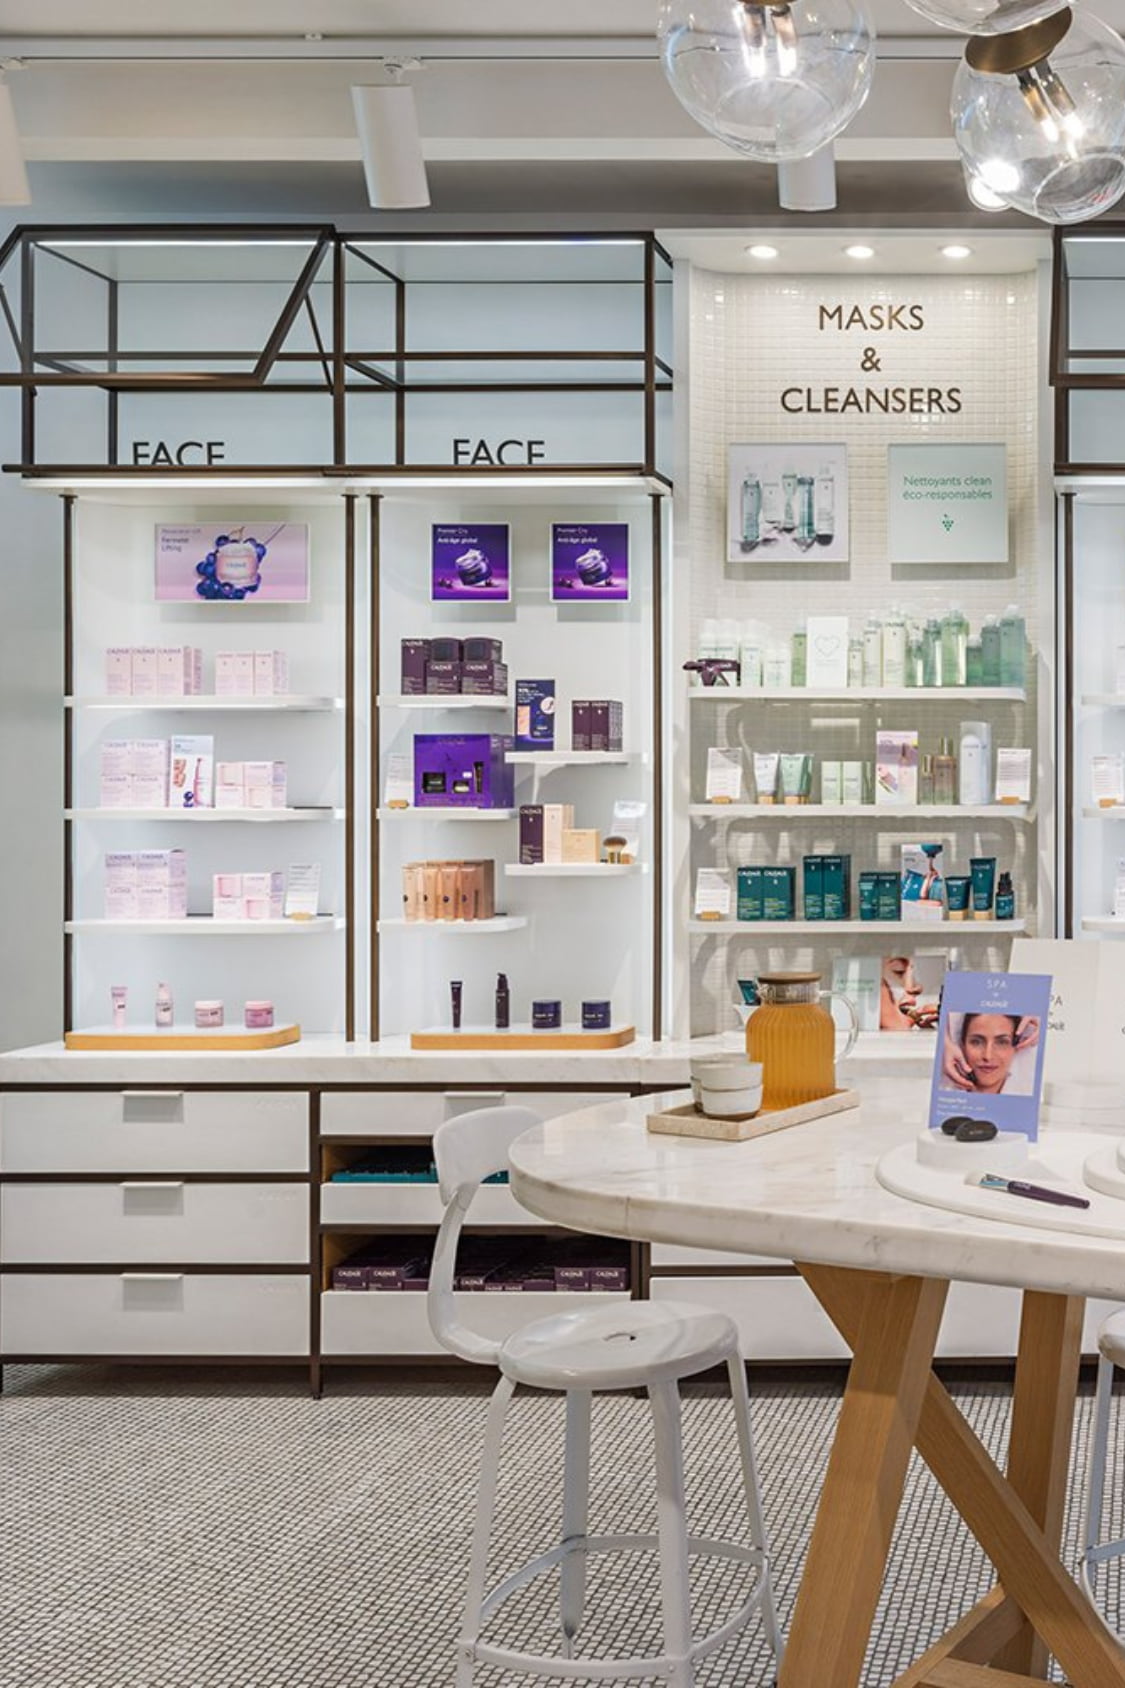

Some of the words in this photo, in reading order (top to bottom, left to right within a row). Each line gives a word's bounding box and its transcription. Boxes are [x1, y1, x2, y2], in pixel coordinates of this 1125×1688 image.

[819, 304, 924, 331] MASKS
[860, 347, 882, 372] &
[780, 387, 962, 414] CLEANSERS
[903, 476, 962, 489] Nettoyants
[964, 476, 992, 487] clean
